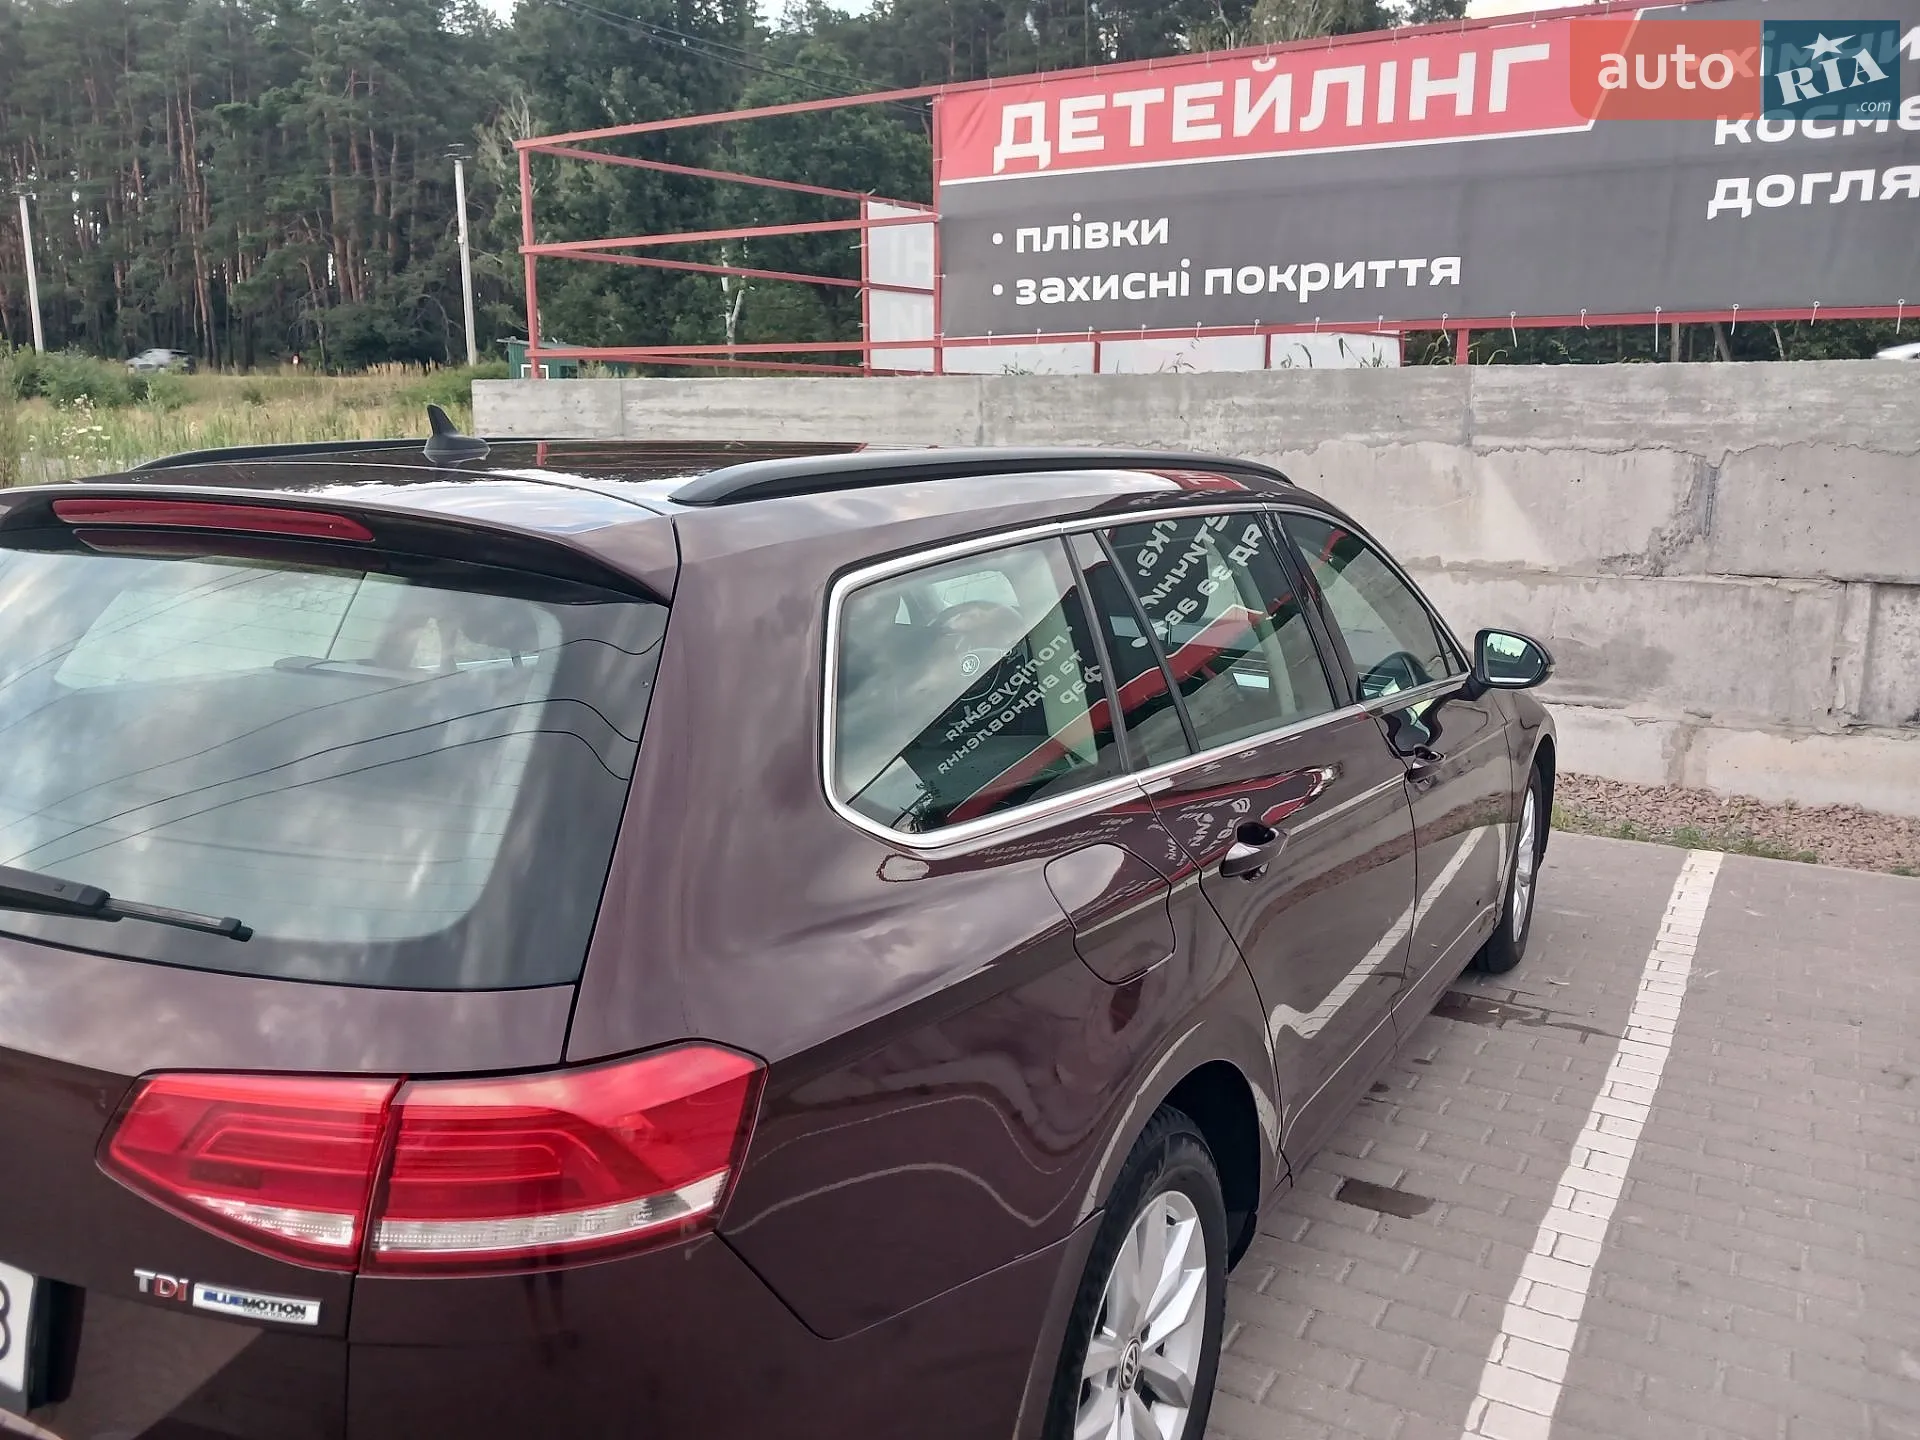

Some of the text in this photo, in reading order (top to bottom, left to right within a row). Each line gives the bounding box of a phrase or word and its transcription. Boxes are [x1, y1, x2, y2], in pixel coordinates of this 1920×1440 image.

[993, 43, 1550, 174] ДЕТЕЙЛІНГ
[1707, 164, 1920, 220] догля
[1015, 212, 1169, 253] плівки
[1015, 256, 1462, 305] захисні покриття
